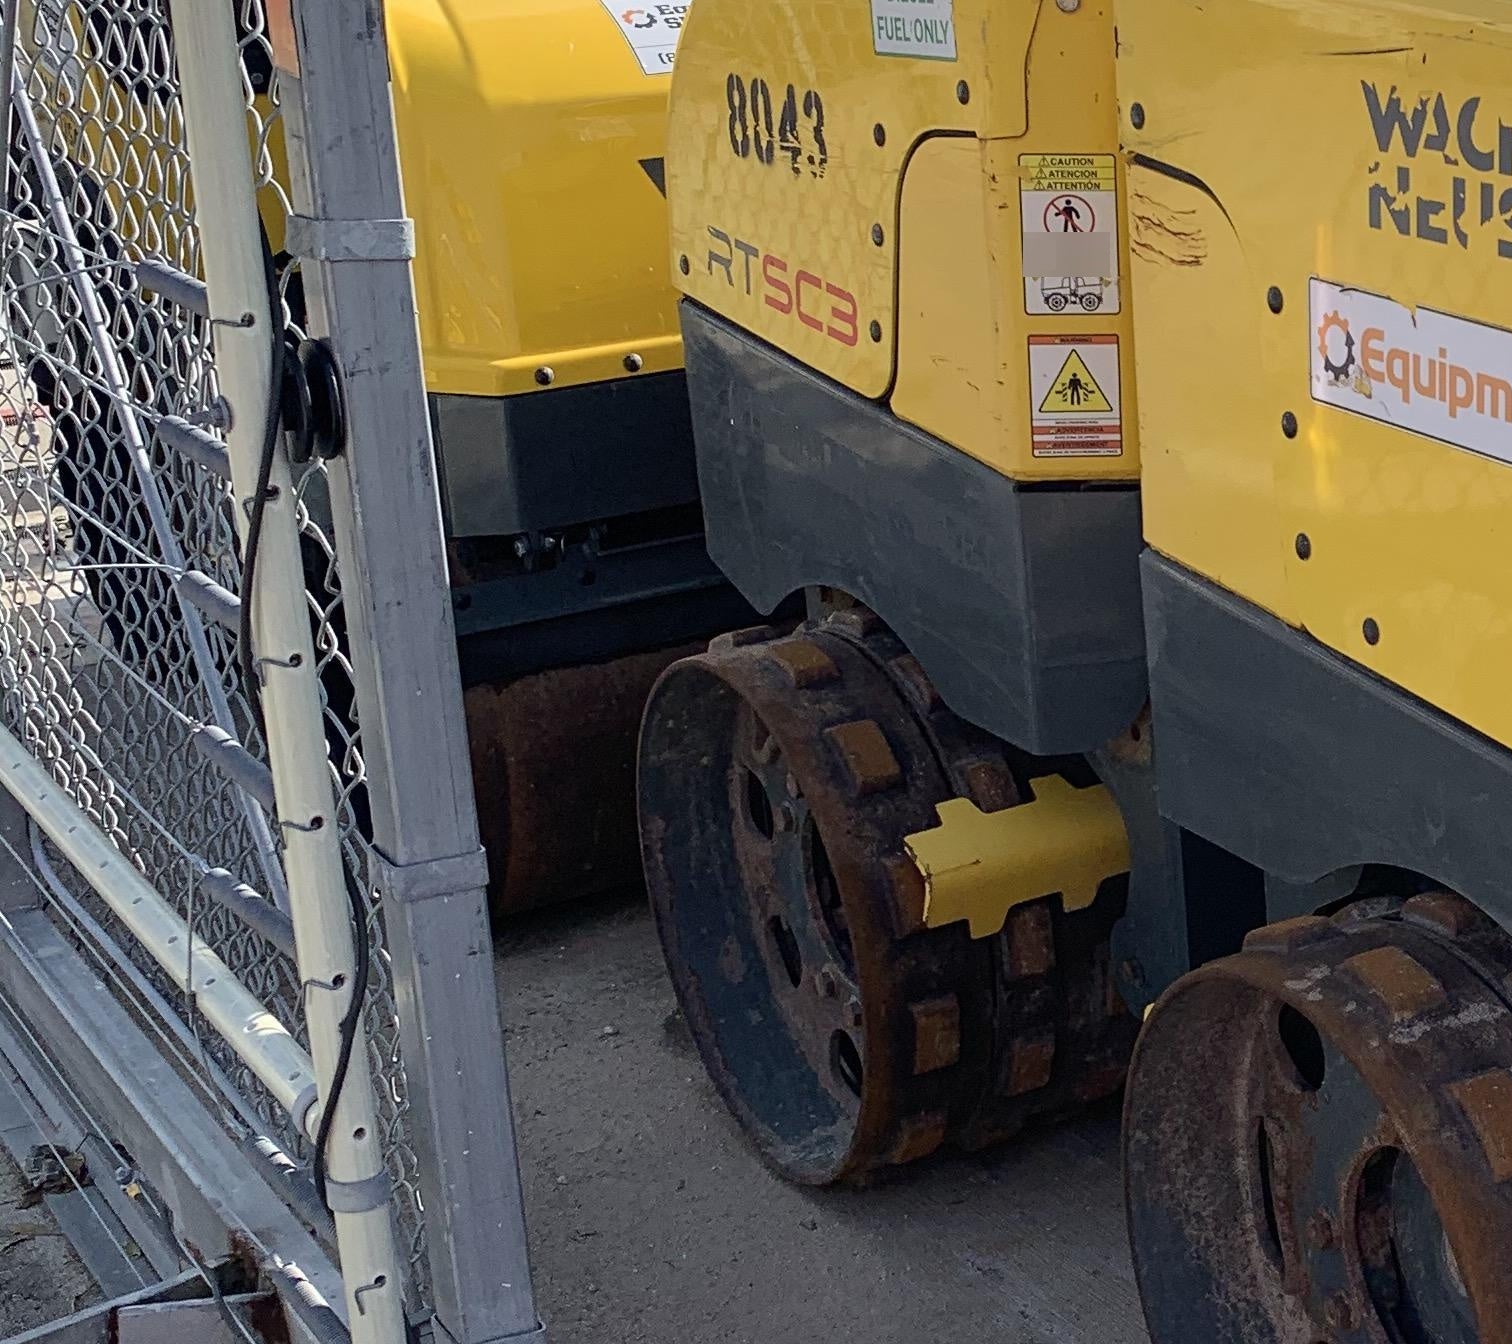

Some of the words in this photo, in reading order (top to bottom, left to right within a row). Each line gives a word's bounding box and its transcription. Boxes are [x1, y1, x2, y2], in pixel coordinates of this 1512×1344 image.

[664, 17, 684, 29] S
[876, 16, 911, 42] FUEL
[914, 18, 949, 44] ONLY
[727, 72, 828, 179] 8043
[1050, 157, 1095, 166] CAUTION
